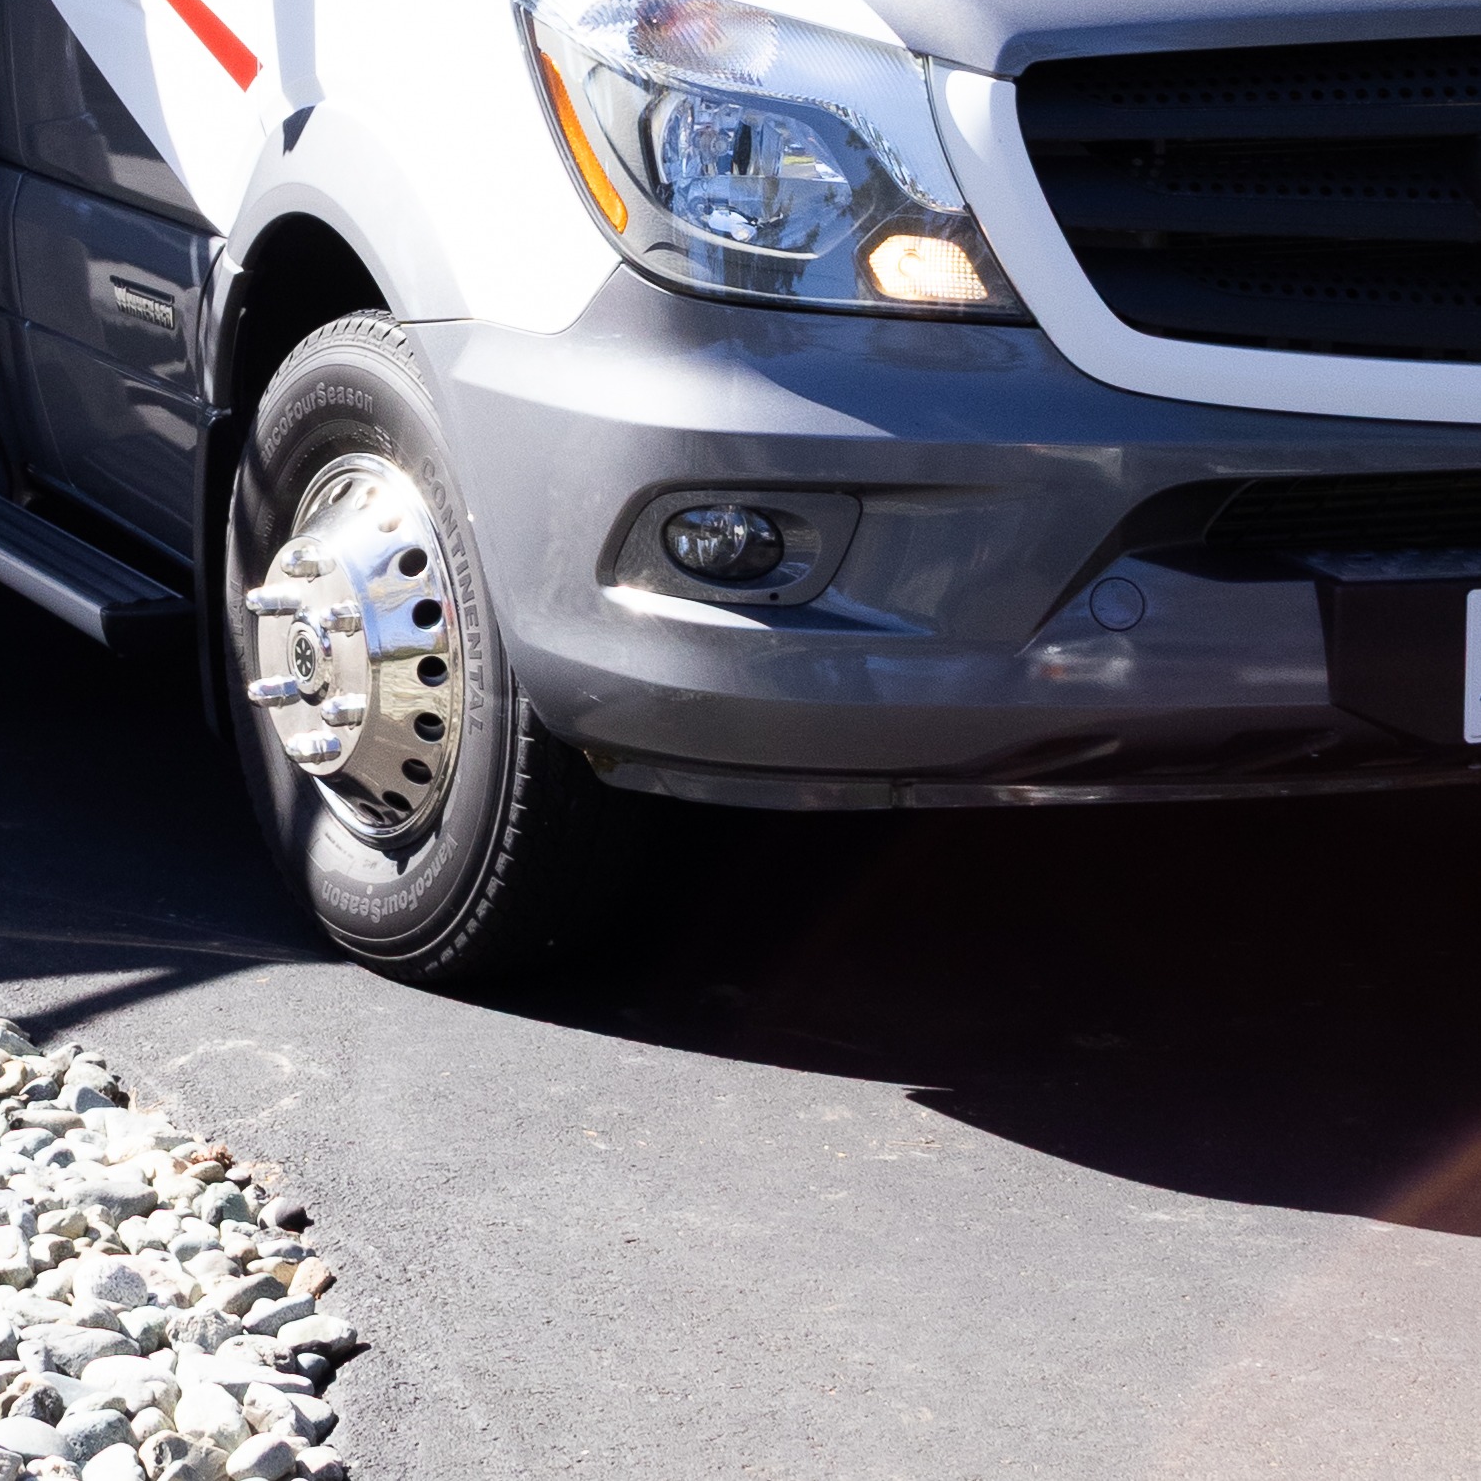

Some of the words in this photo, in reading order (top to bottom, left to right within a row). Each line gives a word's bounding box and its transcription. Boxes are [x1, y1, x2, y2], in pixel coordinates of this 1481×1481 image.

[261, 381, 374, 466] ncoFourSeason
[422, 455, 485, 736] CONTINENTAL
[321, 833, 459, 924] VancoFourSeason
